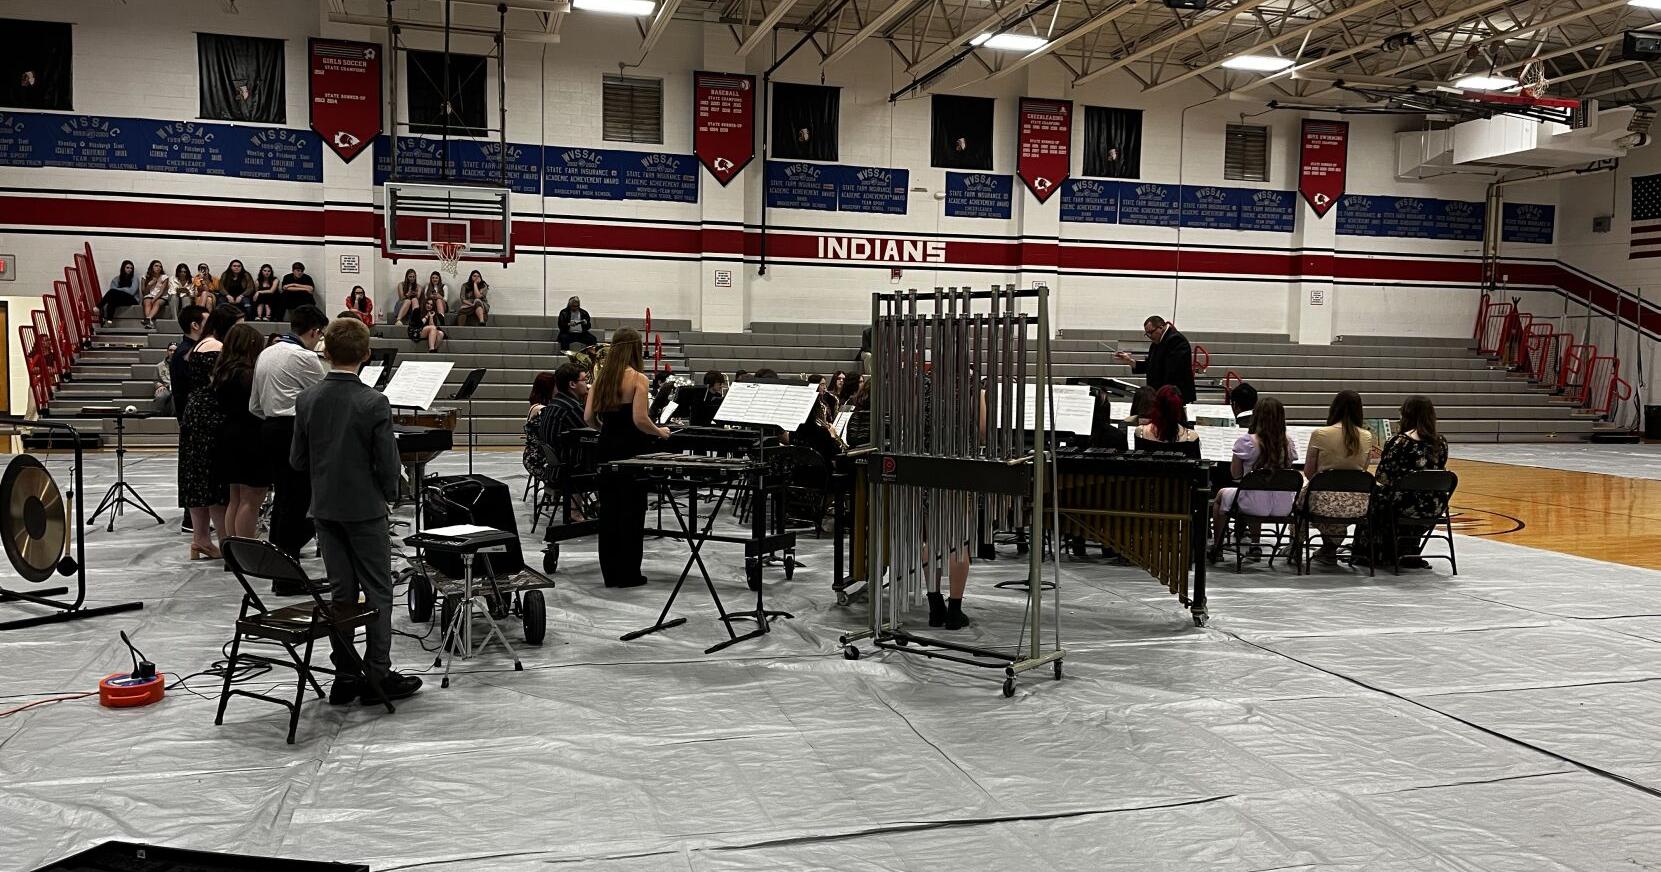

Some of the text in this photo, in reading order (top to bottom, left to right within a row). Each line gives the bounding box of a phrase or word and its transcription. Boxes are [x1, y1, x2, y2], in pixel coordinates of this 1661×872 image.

[561, 149, 603, 164] WVSSAC
[641, 154, 681, 169] WVSSAC
[546, 166, 563, 174] STATE
[580, 168, 609, 176] INSURANCE
[785, 164, 821, 178] WVSSAC
[856, 169, 891, 183] WVSSAC
[964, 175, 998, 189] WVSSAC
[1072, 180, 1105, 194] WVSSAC
[818, 236, 946, 262] INDIANS
